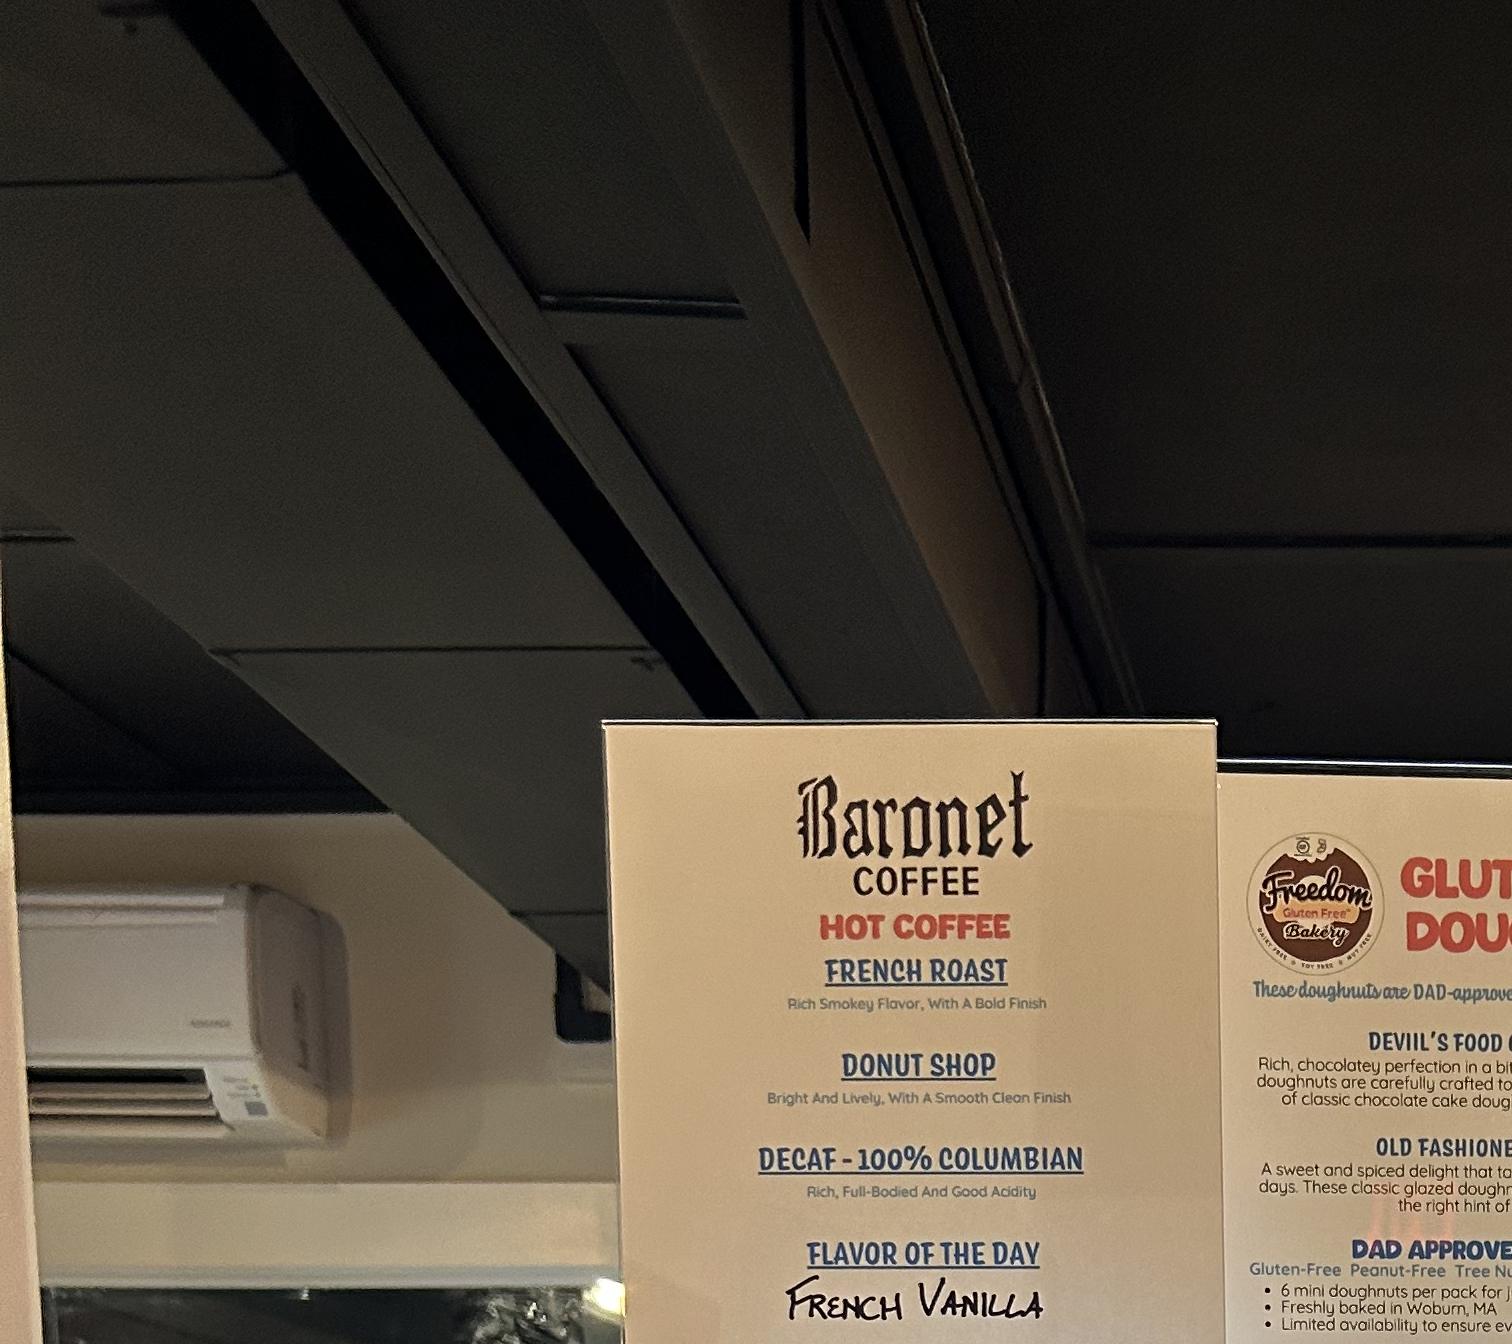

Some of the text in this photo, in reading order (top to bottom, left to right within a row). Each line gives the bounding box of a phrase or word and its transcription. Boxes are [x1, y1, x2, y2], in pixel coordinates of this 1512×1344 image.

[796, 771, 1033, 859] Baronet
[854, 867, 979, 896] COFFEE
[1262, 867, 1371, 912] Freedom
[1283, 908, 1318, 919] Gluten
[820, 914, 1010, 940] HOT COFFEE
[1286, 924, 1346, 945] Bakery
[825, 959, 1007, 982] FRENCH ROAST
[788, 997, 1047, 1013] Rich Smokey Flavor, With A Bold Finish
[1453, 1034, 1502, 1052] FOOD
[842, 1053, 995, 1077] DONUT SHOP
[759, 1148, 836, 1170] DECAF
[858, 1146, 932, 1170] 100%
[939, 1147, 1082, 1170] COLUMBIAN
[1377, 1138, 1411, 1156] OLD
[806, 1242, 1039, 1265] FLAVOR OF THE DAY
[1352, 1240, 1402, 1259] DAD
[1250, 1262, 1341, 1276] Gluten-Free
[1351, 1263, 1446, 1277] Peanut-Free
[1455, 1265, 1490, 1277] Tree
[785, 1275, 1043, 1320] FRENCH VANILLA
[1282, 1300, 1497, 1317] Freshly baked in Woburn, MA
